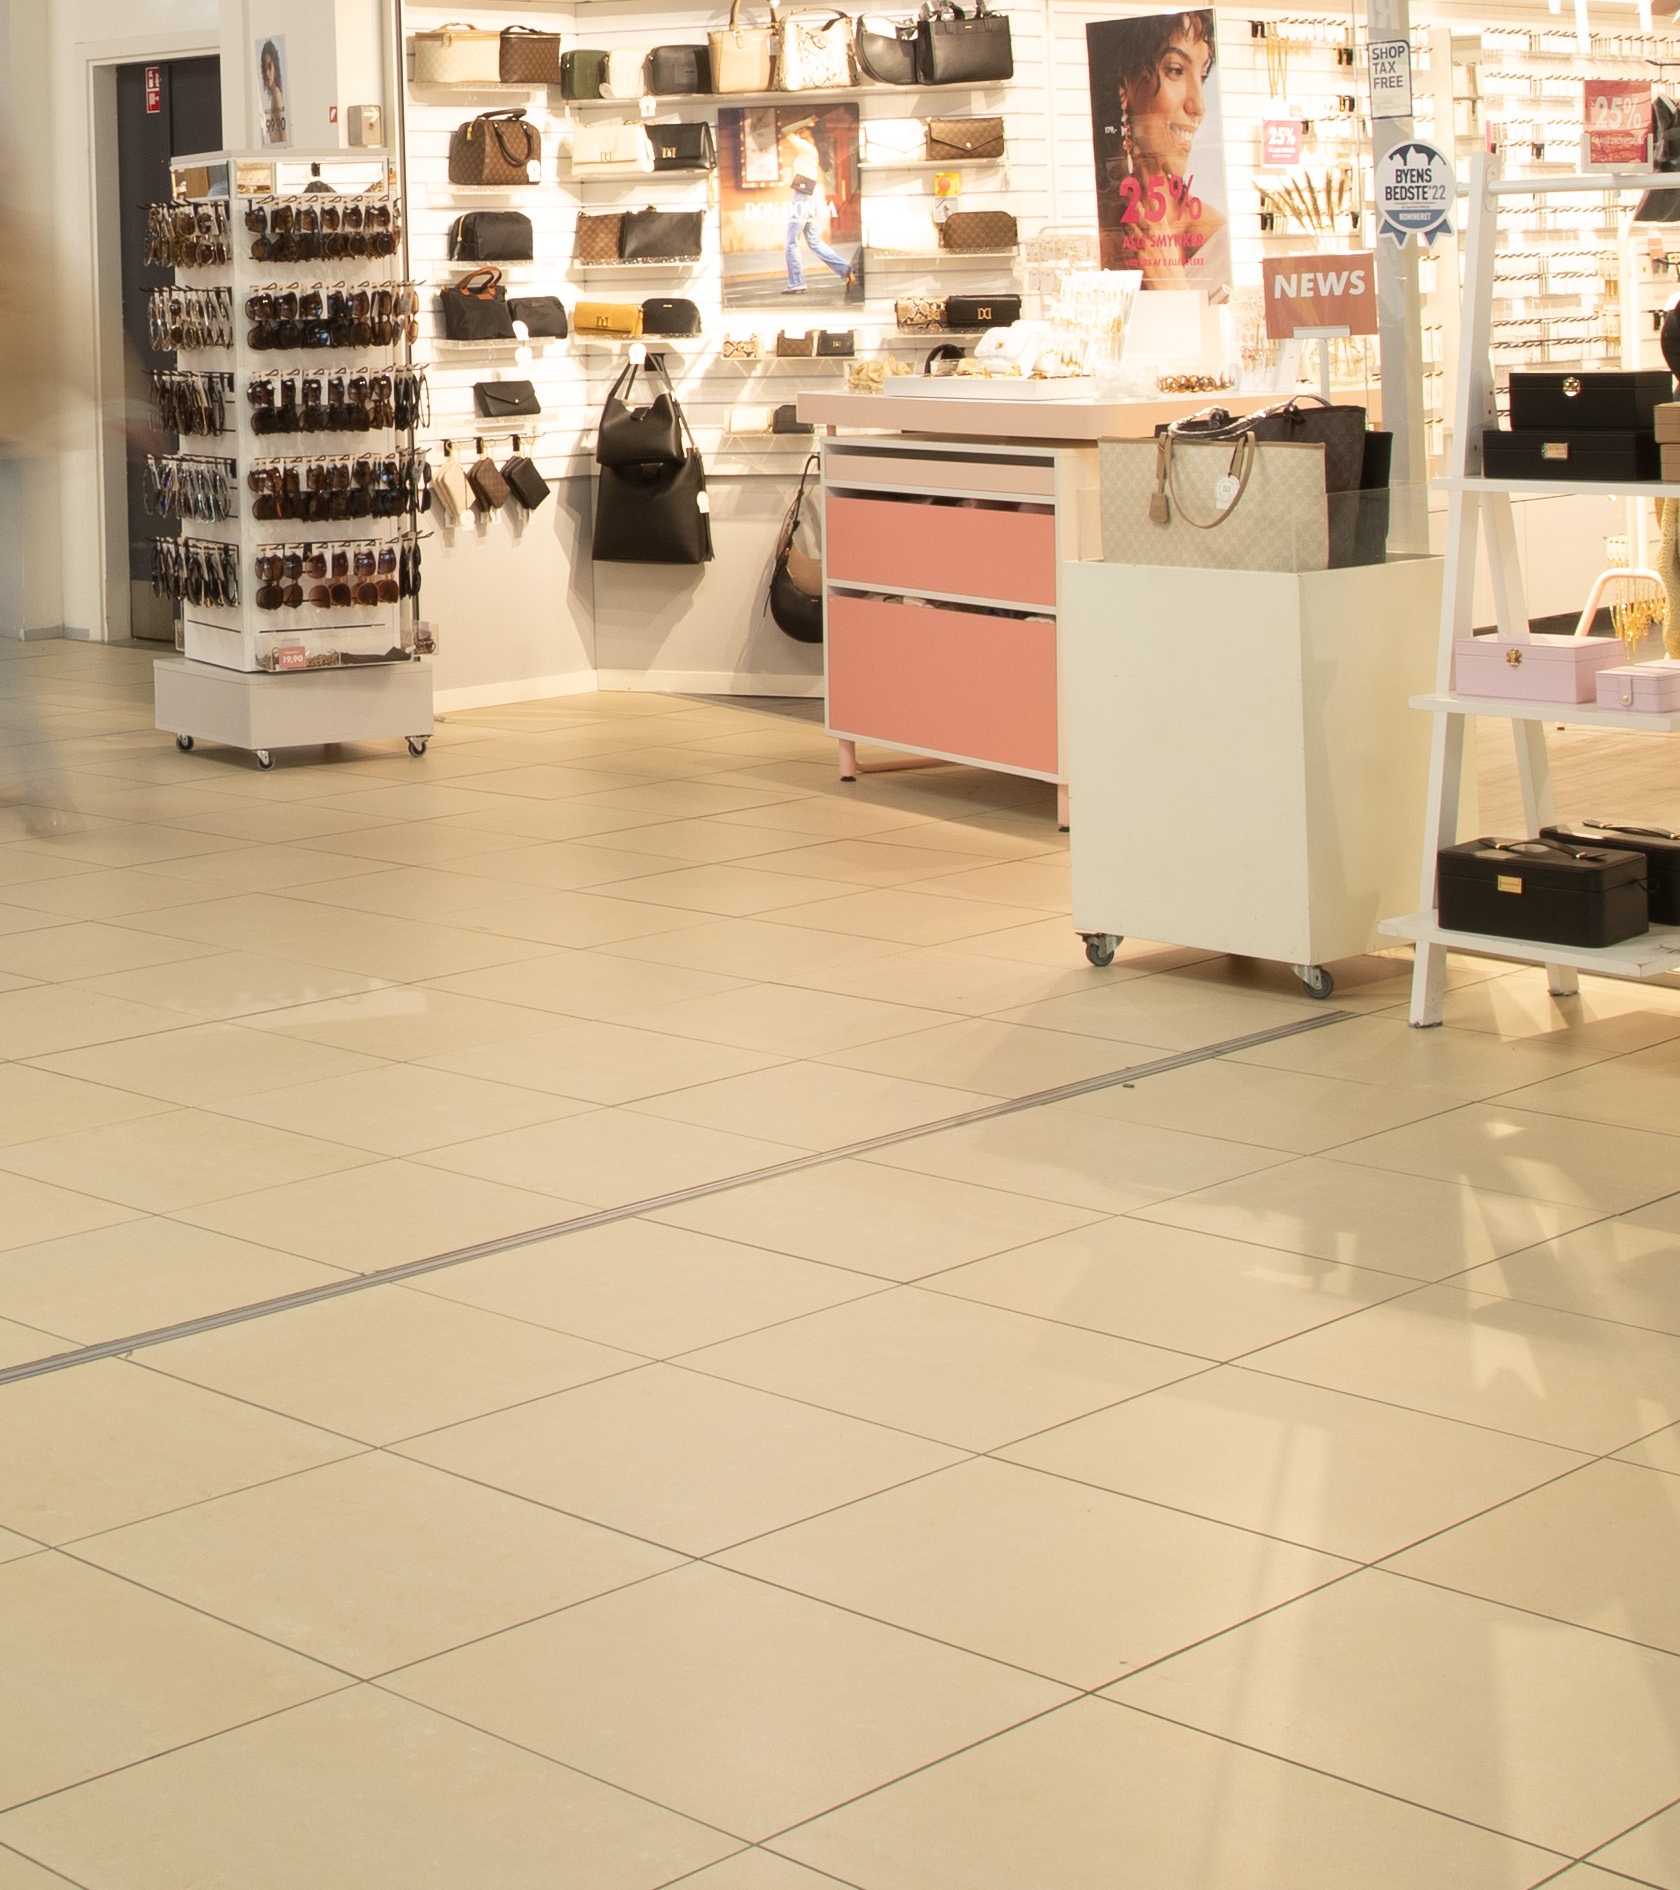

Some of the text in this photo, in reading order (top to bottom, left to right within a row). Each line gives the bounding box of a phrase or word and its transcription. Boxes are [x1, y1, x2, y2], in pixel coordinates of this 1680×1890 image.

[1372, 45, 1406, 60] SHOP
[1373, 61, 1396, 75] TAX
[1374, 75, 1404, 90] FREE
[1594, 96, 1642, 129] 25%
[1268, 126, 1296, 146] 25%
[1395, 169, 1432, 183] BYENS
[1119, 175, 1203, 224] 25%
[1274, 270, 1366, 300] NEWS
[282, 655, 304, 664] 19,90
